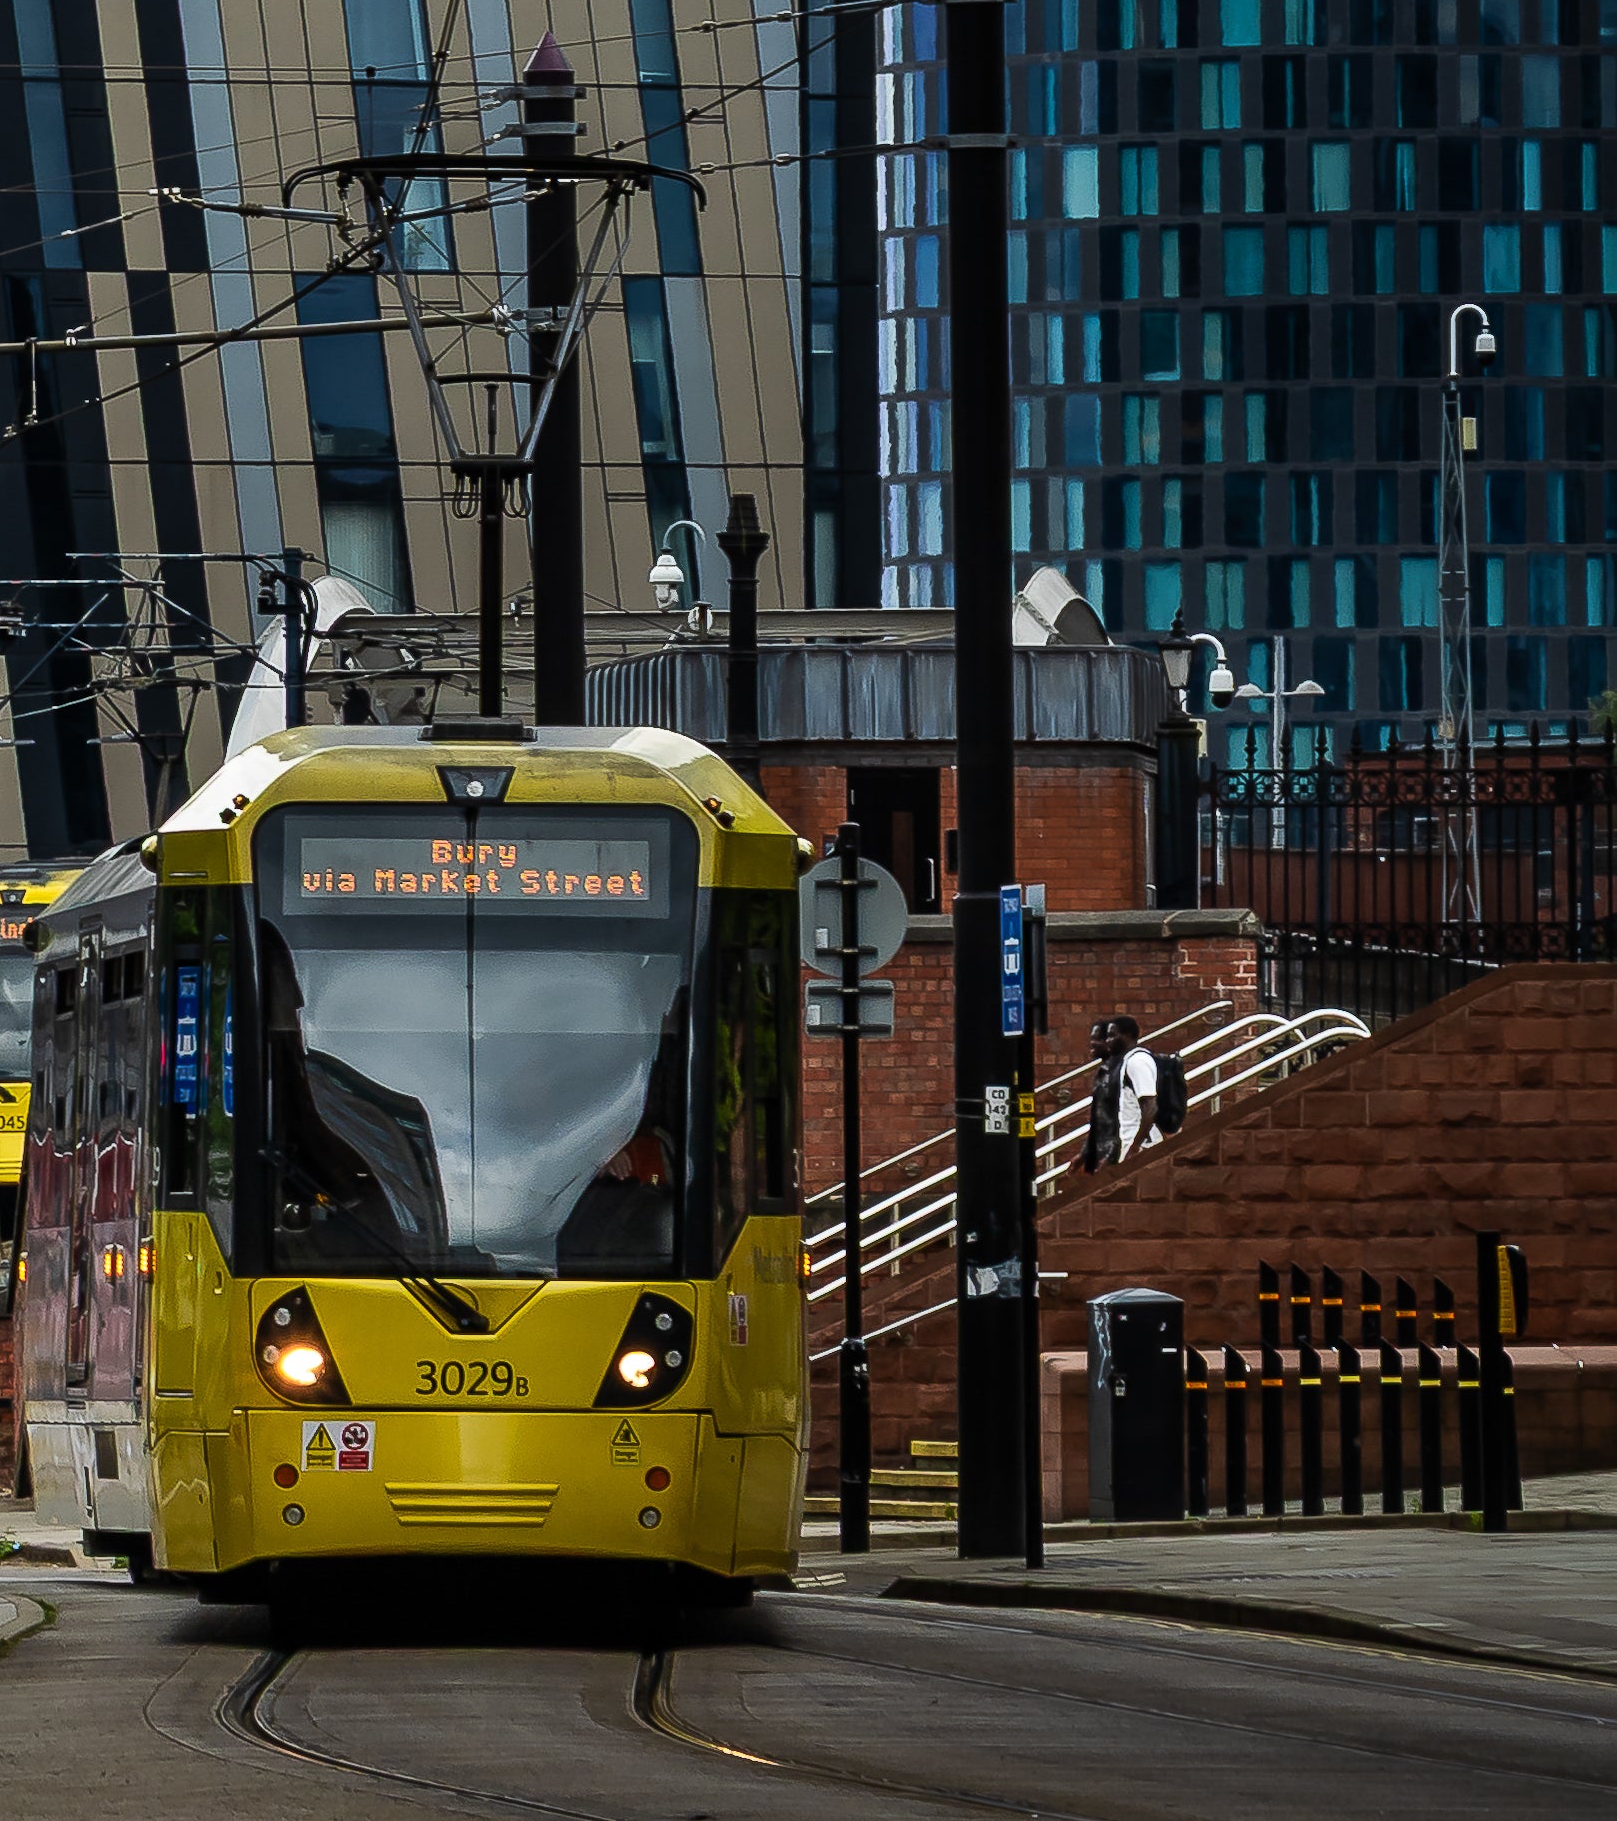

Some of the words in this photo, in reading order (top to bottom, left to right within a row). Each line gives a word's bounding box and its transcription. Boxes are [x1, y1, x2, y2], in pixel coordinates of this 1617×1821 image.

[431, 839, 518, 869] Bury
[303, 867, 357, 893] via
[374, 868, 502, 894] Market
[520, 869, 645, 896] Street
[991, 1089, 1005, 1100] CD
[994, 1121, 1002, 1130] D
